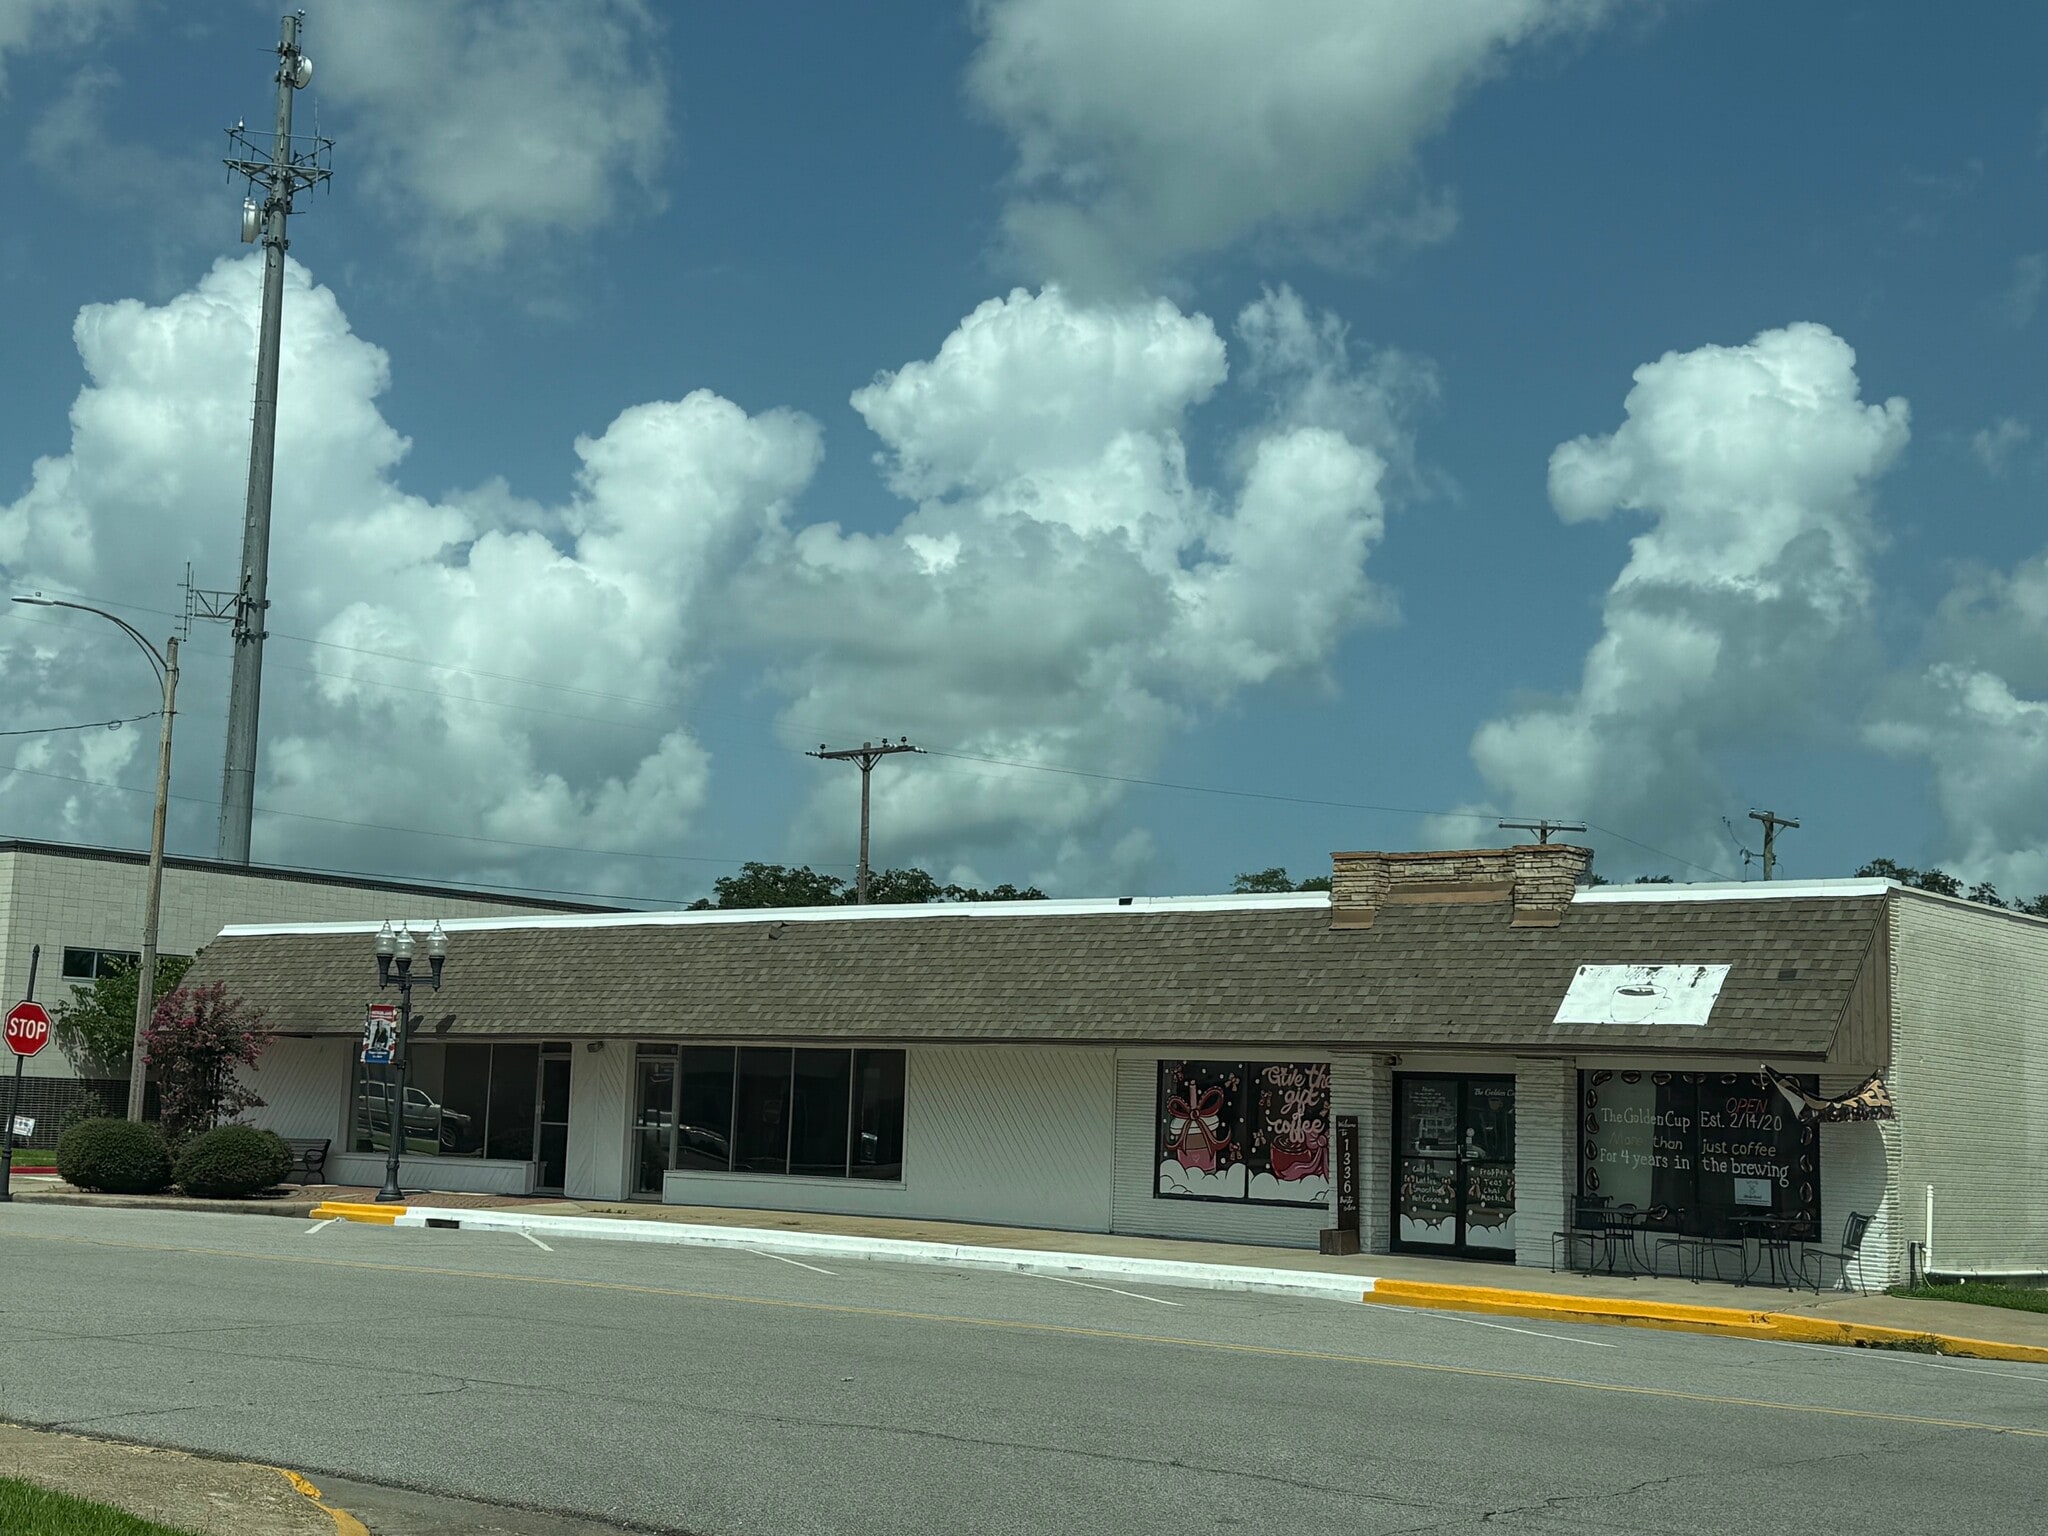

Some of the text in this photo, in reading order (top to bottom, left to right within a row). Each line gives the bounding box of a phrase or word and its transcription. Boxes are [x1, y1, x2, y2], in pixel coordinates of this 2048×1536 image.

[8, 1017, 47, 1039] STOP
[1262, 1066, 1305, 1087] Give
[1281, 1087, 1320, 1114] gift
[1725, 1097, 1768, 1114] OPEN
[1266, 1115, 1325, 1143] coffee
[1601, 1107, 1782, 1133] The Golden Cup Est. 2/14/20
[1653, 1136, 1683, 1150] than
[1701, 1139, 1728, 1154] just
[1731, 1141, 1776, 1156] coffee
[1343, 1138, 1352, 1194] 1336
[1600, 1148, 1789, 1187] For 4 years in the brewing
[1484, 1179, 1502, 1187] Teas
[1480, 1194, 1506, 1203] Mocha
